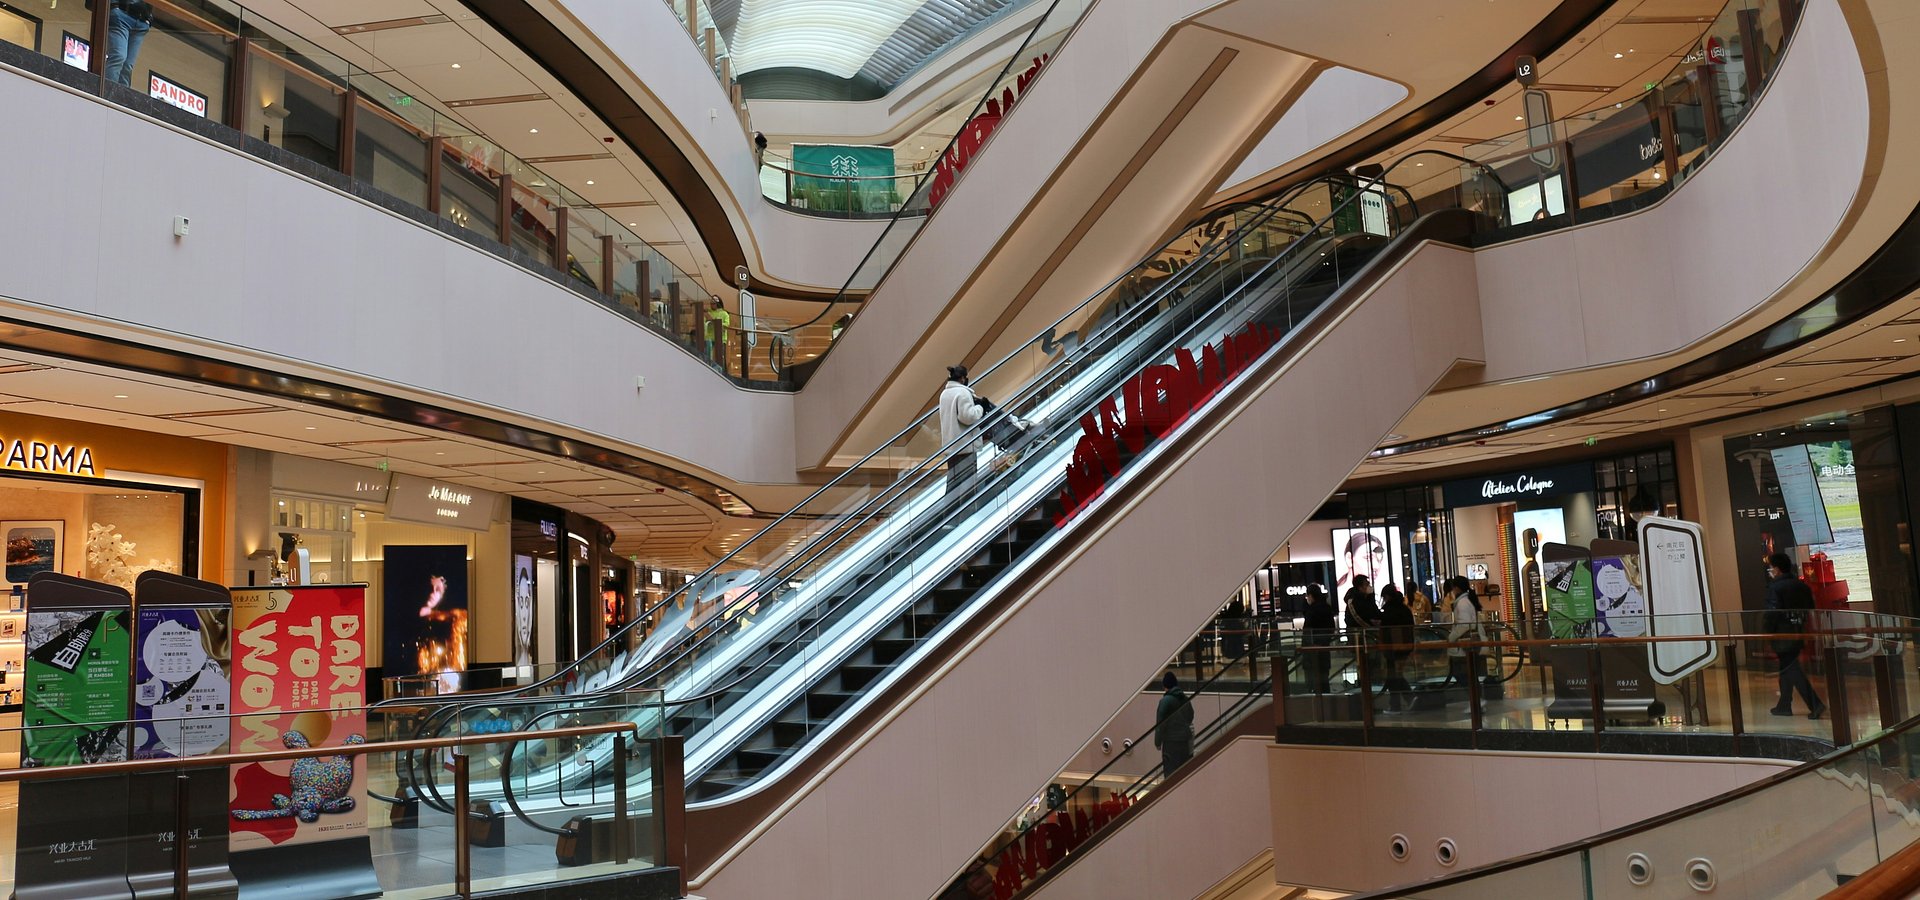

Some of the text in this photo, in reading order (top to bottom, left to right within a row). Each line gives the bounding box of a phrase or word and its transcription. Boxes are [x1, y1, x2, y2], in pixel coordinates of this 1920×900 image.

[1519, 65, 1531, 76] L2
[152, 78, 204, 112] SANDRO
[739, 273, 747, 281] L2
[0, 438, 95, 475] ARMA
[1821, 464, 1856, 476] 电动全
[440, 487, 472, 505] MALONE
[1481, 475, 1554, 498] Atelier Cologne
[1737, 507, 1785, 518] TESLA
[288, 615, 322, 678] TO
[328, 615, 362, 720] DARE
[238, 620, 281, 754] WOW
[292, 681, 300, 709] MORE
[301, 681, 309, 701] FOR
[311, 681, 319, 706] DARE
